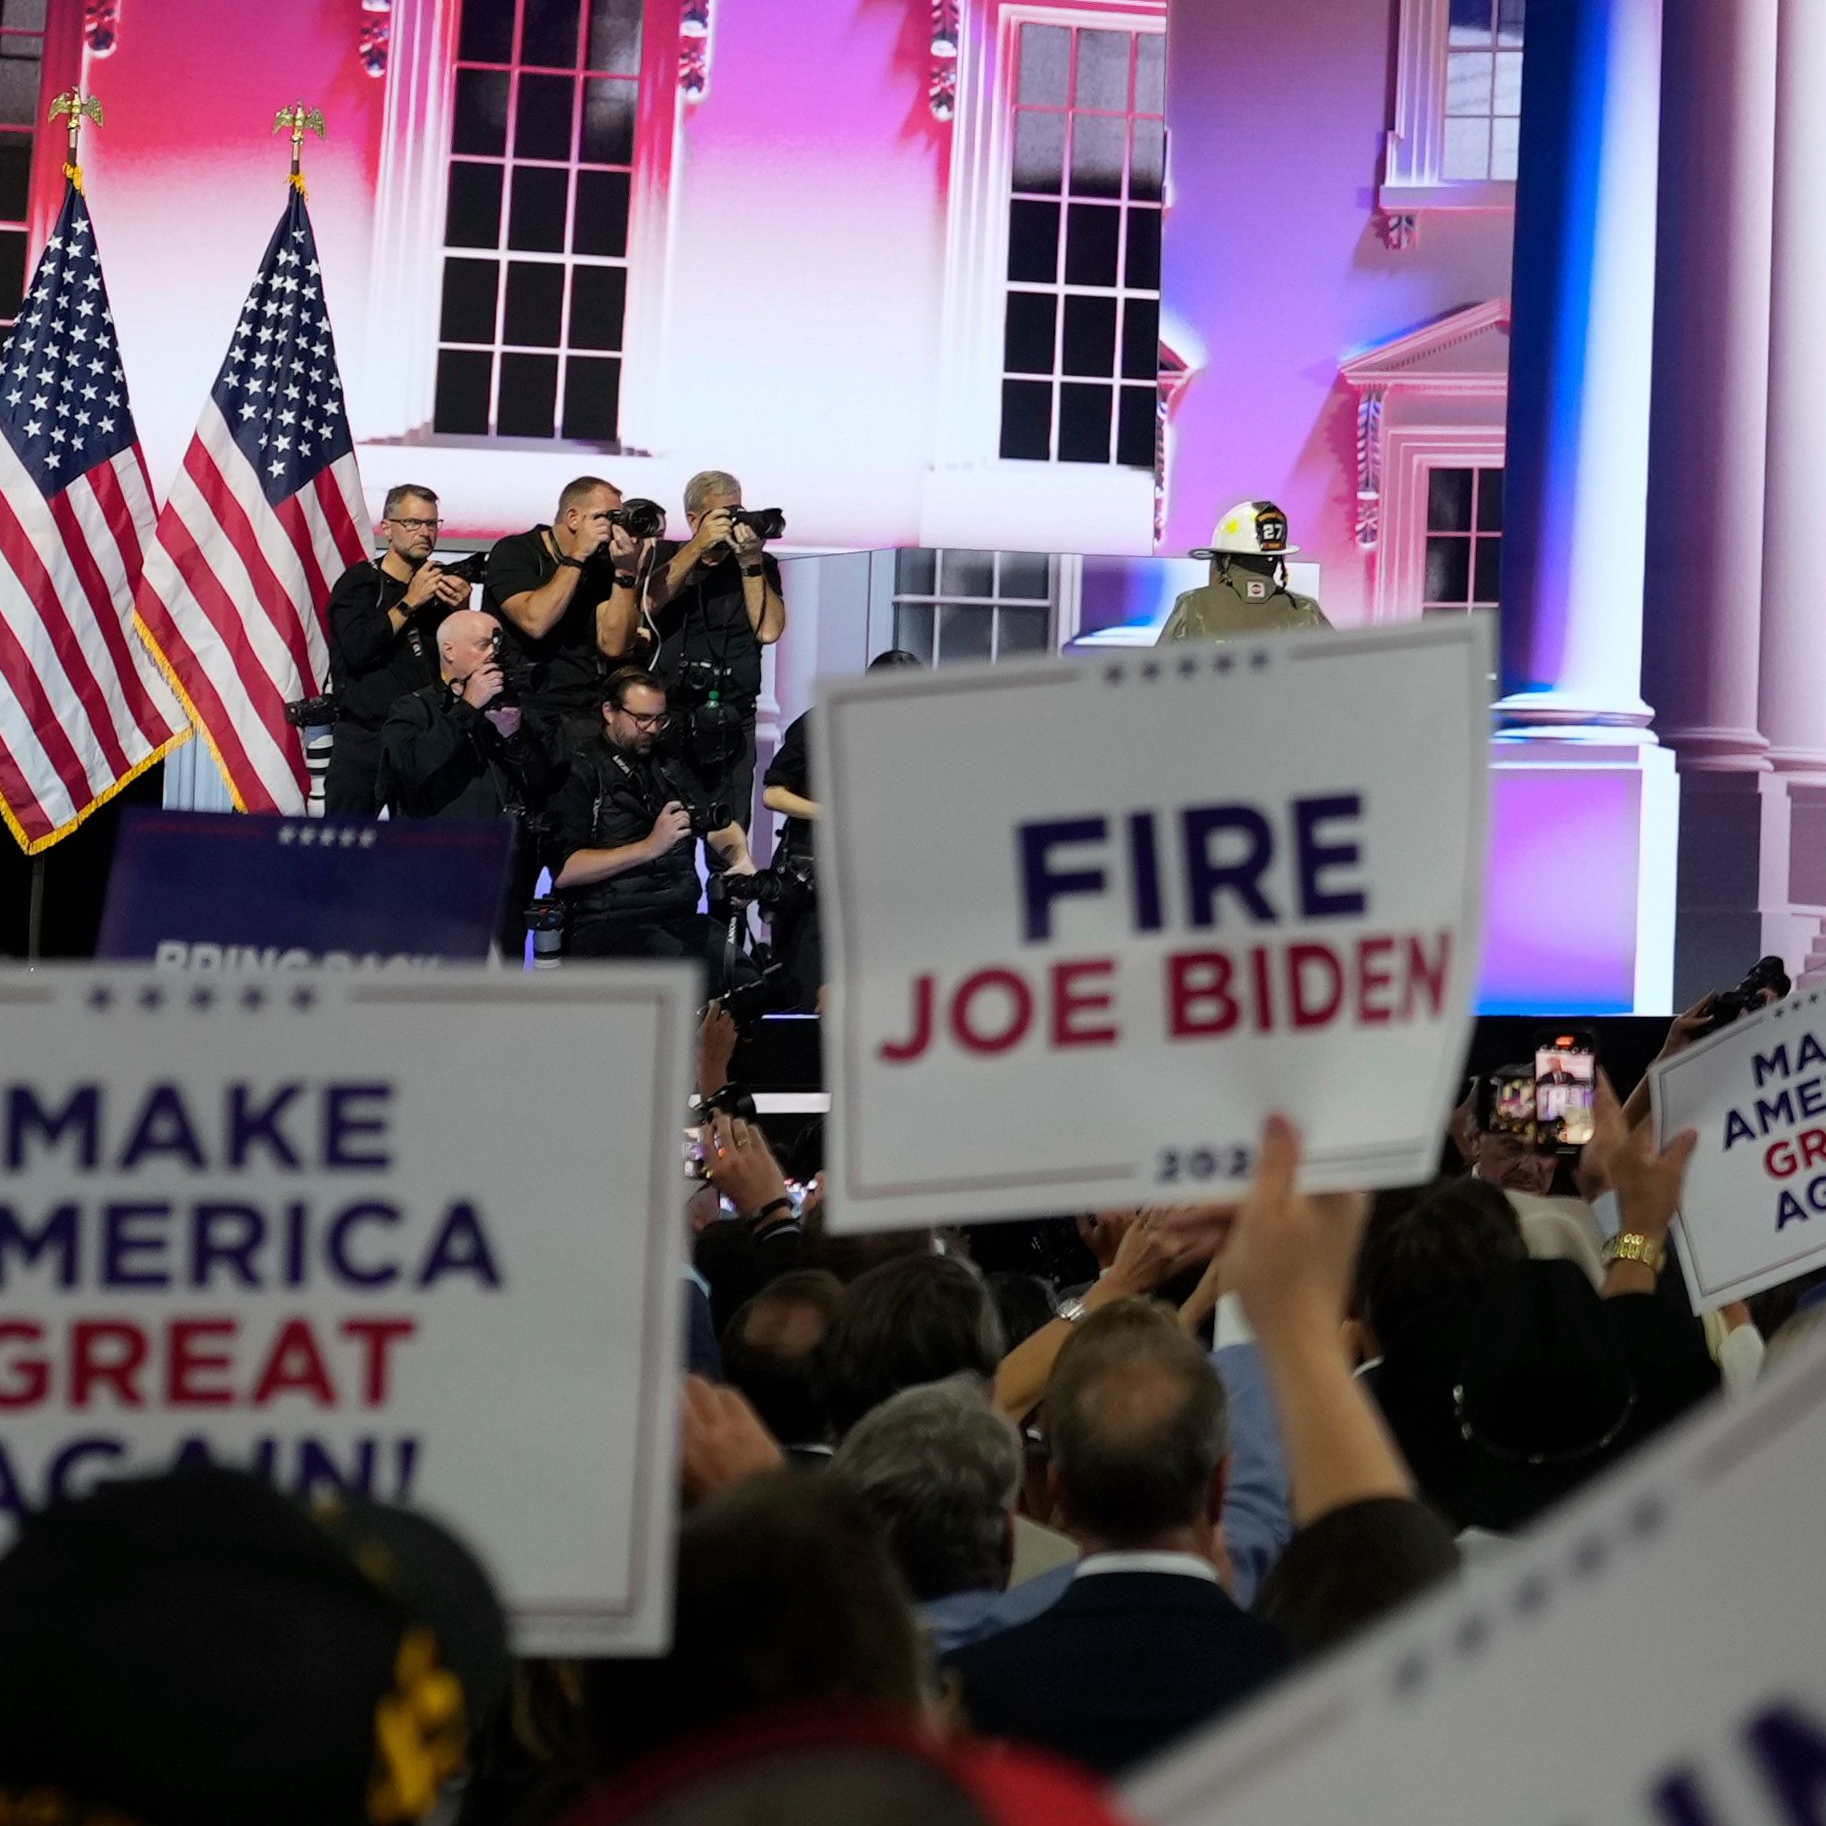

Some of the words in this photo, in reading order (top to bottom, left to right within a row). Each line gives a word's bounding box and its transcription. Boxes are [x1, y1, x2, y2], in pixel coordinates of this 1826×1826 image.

[1262, 523, 1284, 541] 27
[1017, 790, 1368, 944] FIRE
[875, 958, 1117, 1064] JOE
[1164, 929, 1453, 1042] BIDEN
[5, 1084, 394, 1172] MAKE
[0, 1319, 416, 1409] GREAT
